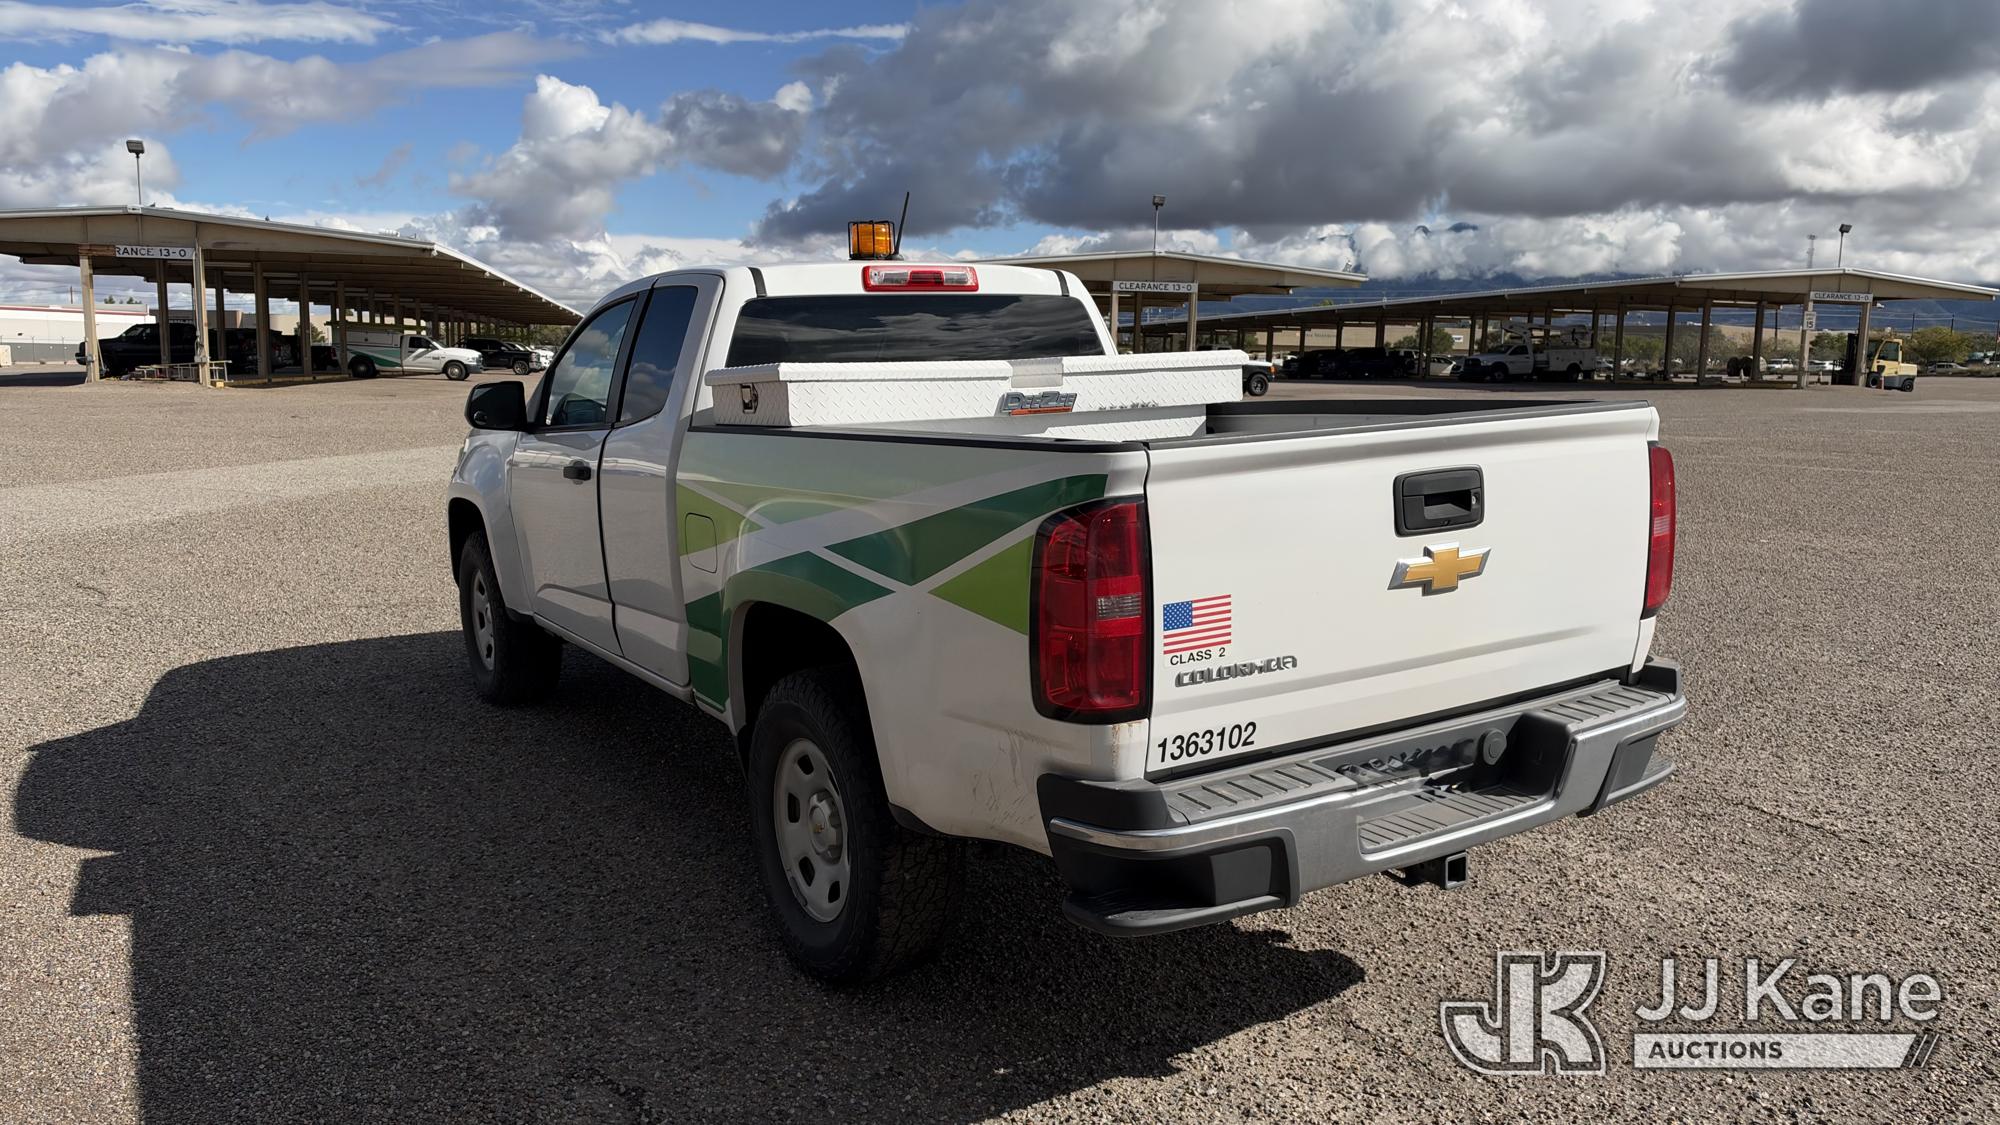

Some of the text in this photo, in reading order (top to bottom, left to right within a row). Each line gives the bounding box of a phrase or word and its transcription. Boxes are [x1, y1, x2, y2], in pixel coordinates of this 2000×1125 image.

[1118, 282, 1169, 291] CLEARANCE
[1814, 292, 1851, 300] CLEARANCE
[1806, 320, 1814, 328] 15
[1170, 647, 1226, 666] CLASS 2
[1157, 721, 1257, 763] 1363102
